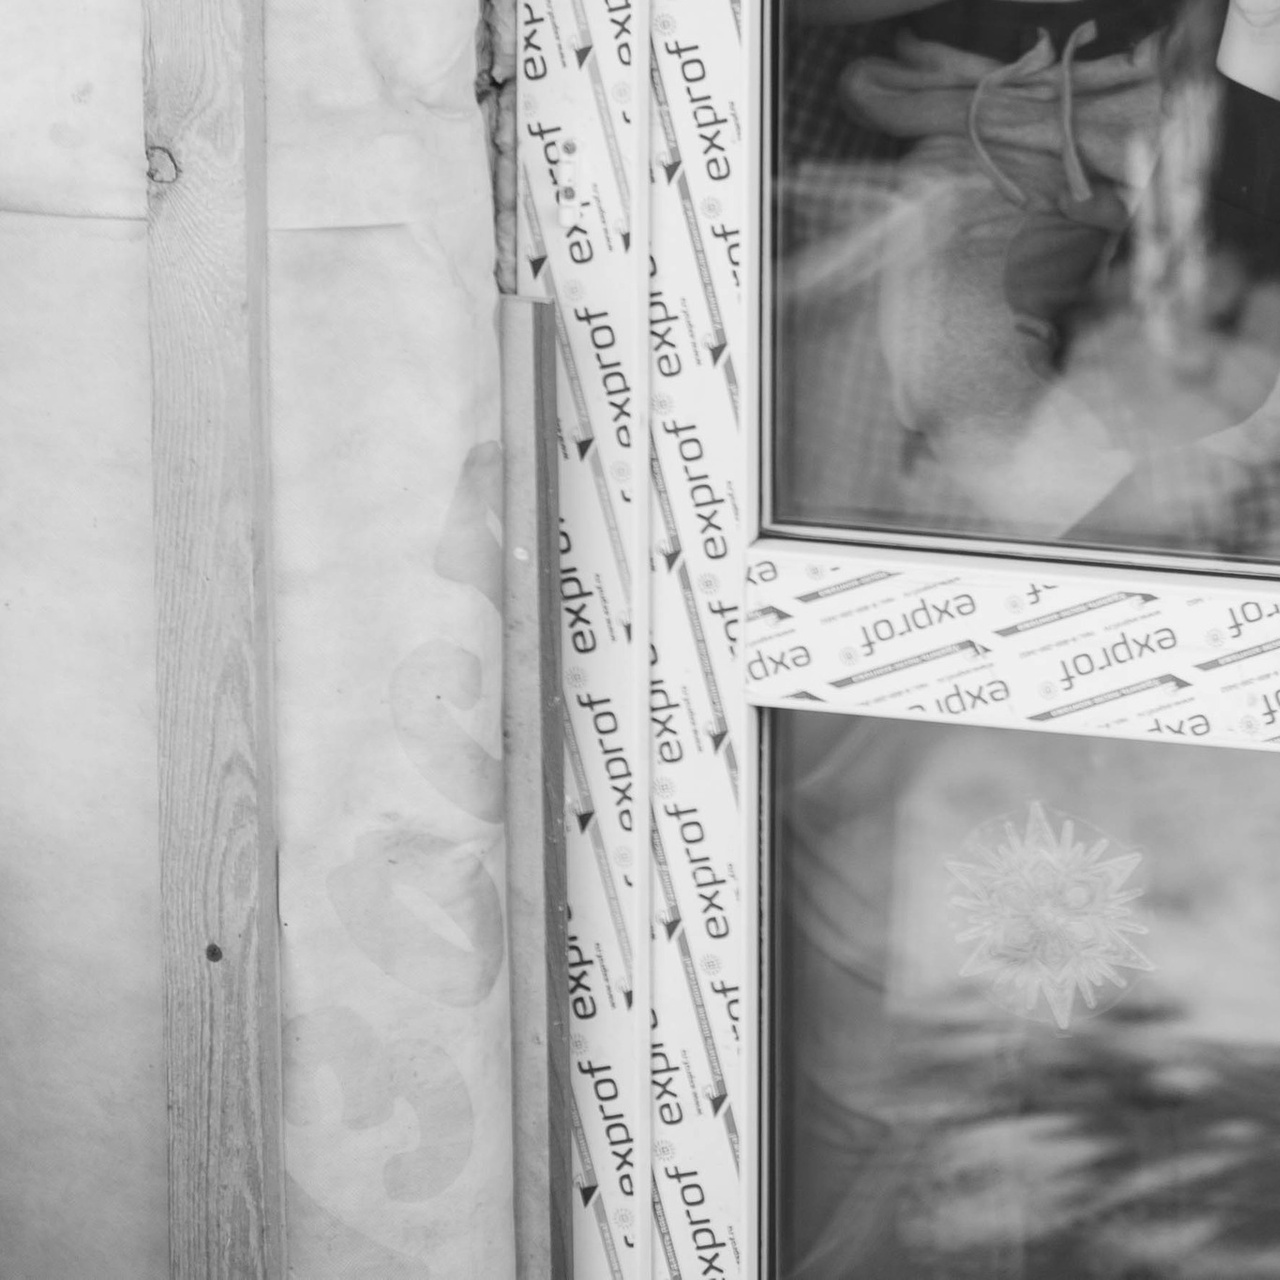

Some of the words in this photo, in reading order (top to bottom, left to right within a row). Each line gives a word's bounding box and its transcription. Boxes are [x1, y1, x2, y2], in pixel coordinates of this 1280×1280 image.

[664, 39, 731, 182] exprof
[574, 305, 631, 449] exprof
[663, 419, 727, 560] exprof
[861, 594, 977, 657] exprof
[1059, 627, 1178, 691] exprof
[577, 692, 633, 833] exprof
[664, 802, 730, 940] exprof
[578, 1059, 633, 1197] exprof
[664, 1165, 726, 1280] xprof
